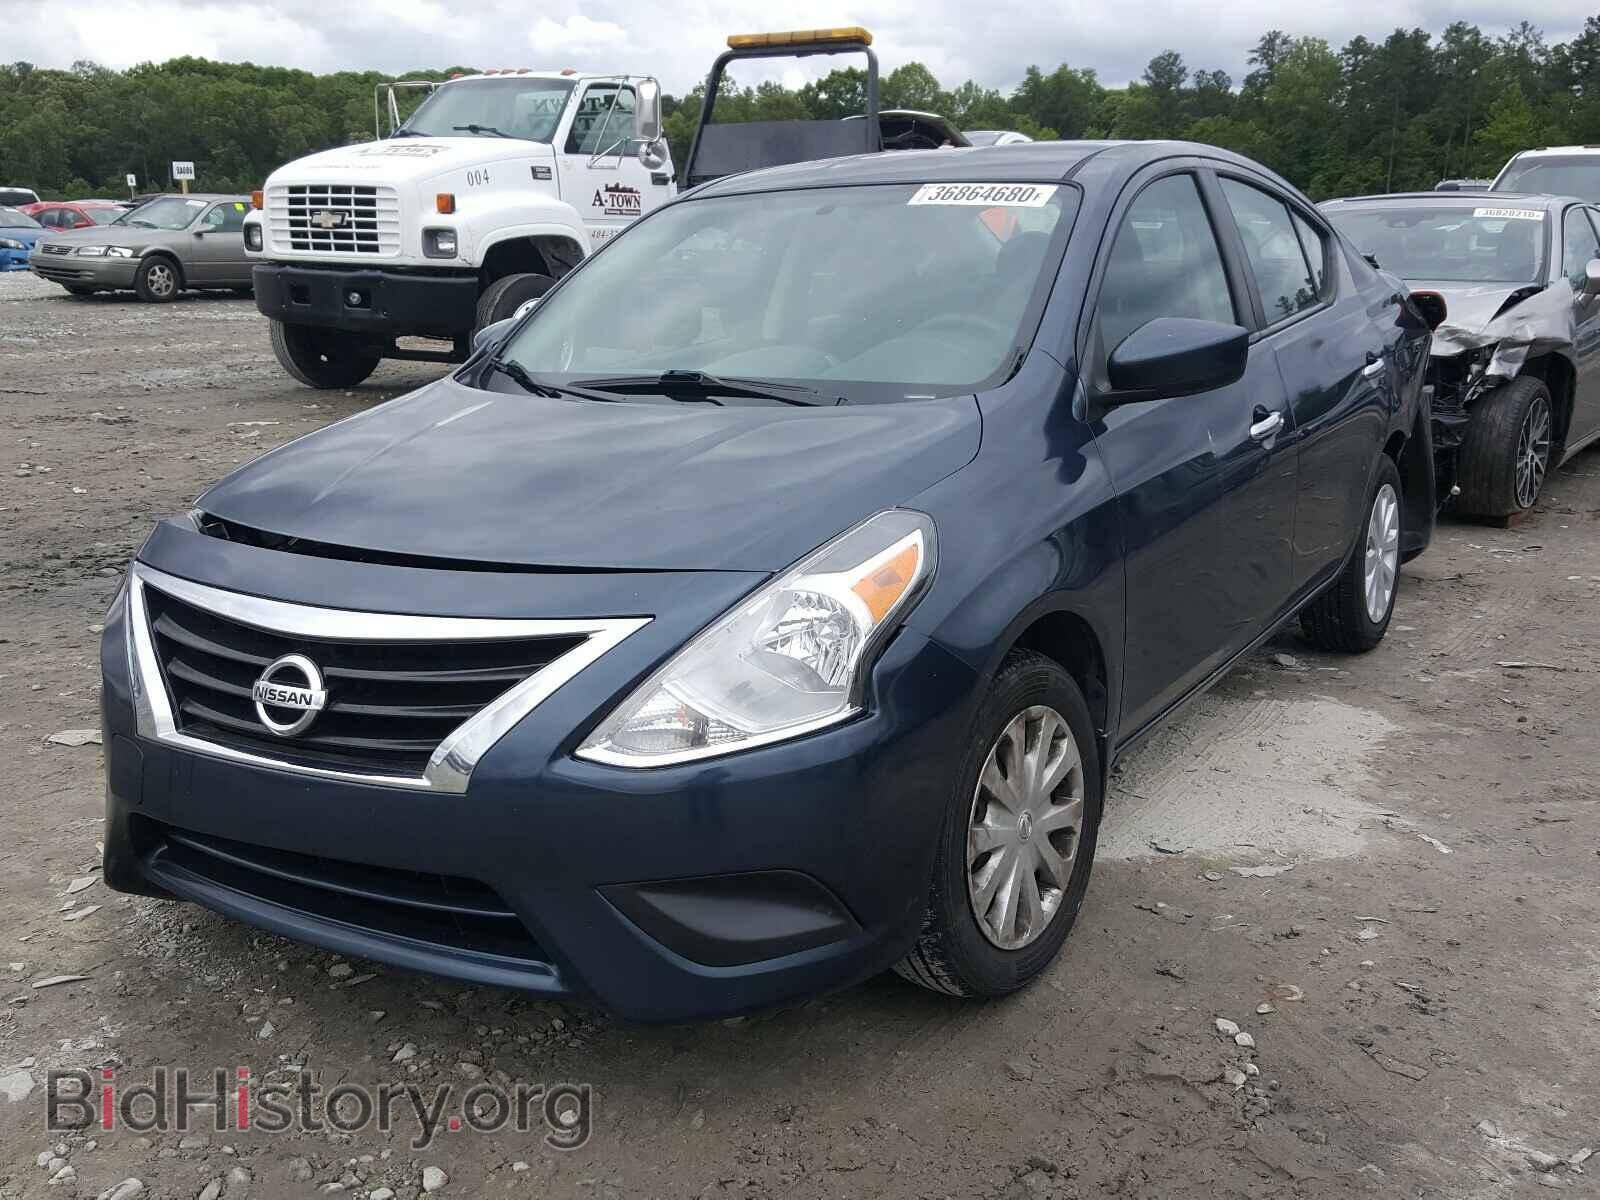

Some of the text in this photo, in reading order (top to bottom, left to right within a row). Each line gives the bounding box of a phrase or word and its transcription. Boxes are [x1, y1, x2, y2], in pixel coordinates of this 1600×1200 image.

[467, 168, 490, 186] 004
[928, 186, 1035, 202] 36864680
[254, 686, 313, 706] NISSAN
